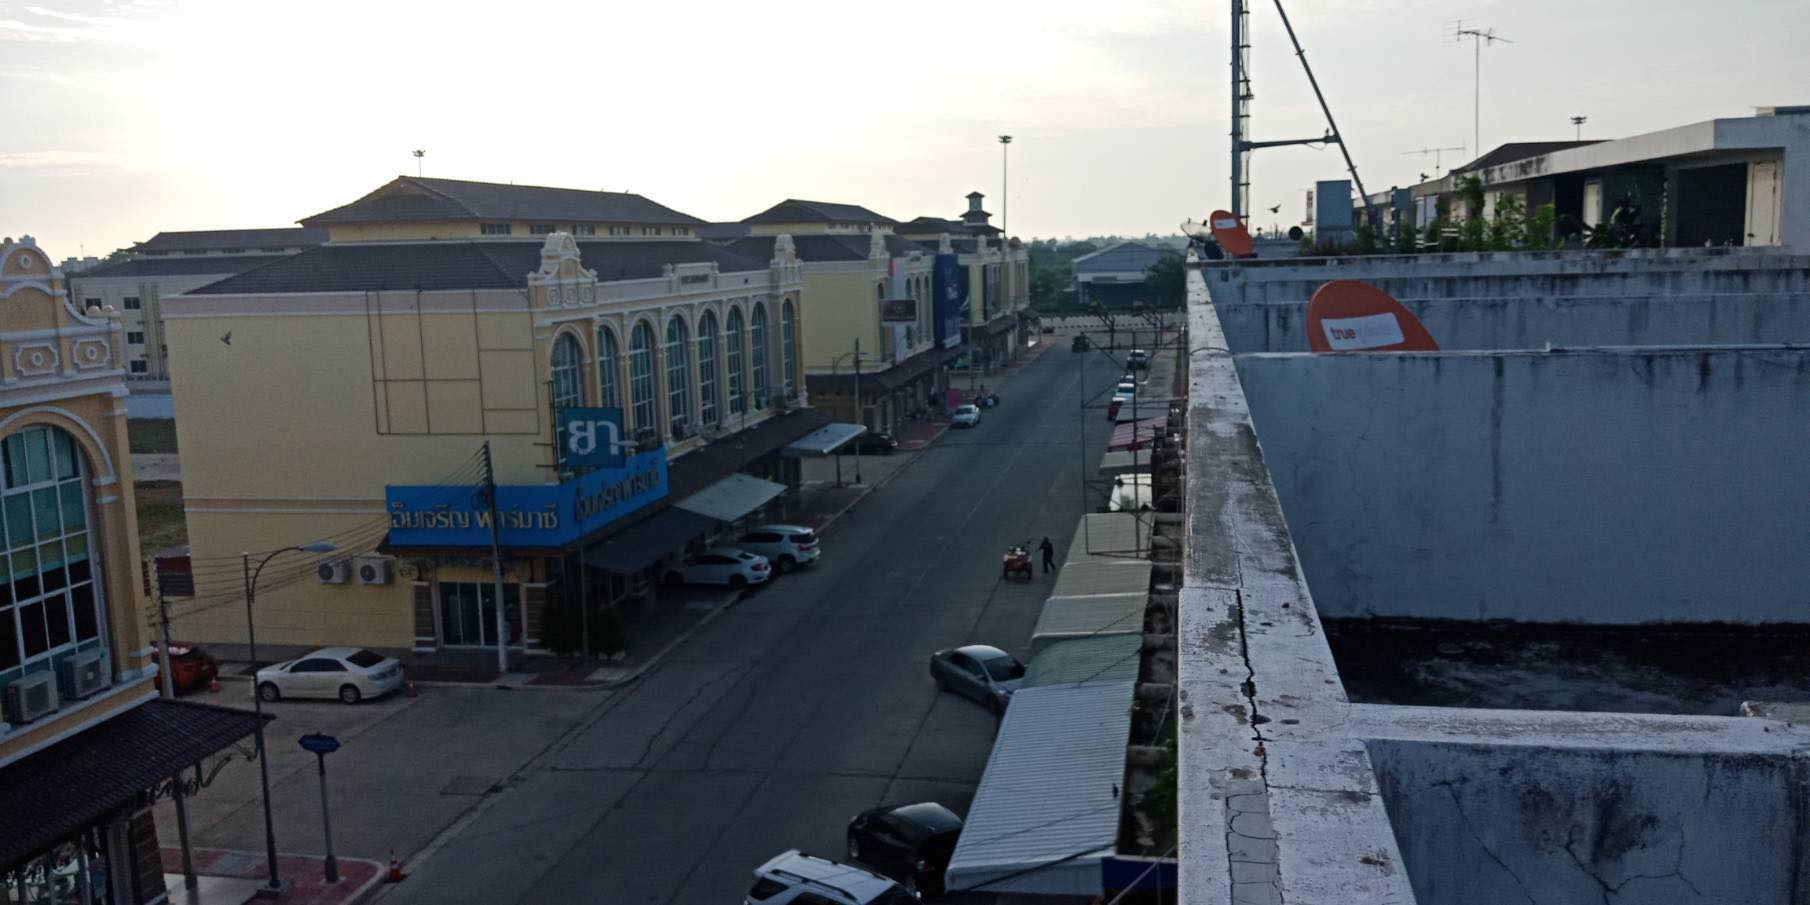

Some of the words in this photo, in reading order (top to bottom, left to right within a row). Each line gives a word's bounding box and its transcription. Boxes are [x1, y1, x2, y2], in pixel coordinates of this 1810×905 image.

[1330, 326, 1357, 340] true
[568, 420, 619, 455] ยา
[387, 501, 470, 528] เอ็มเจริญ
